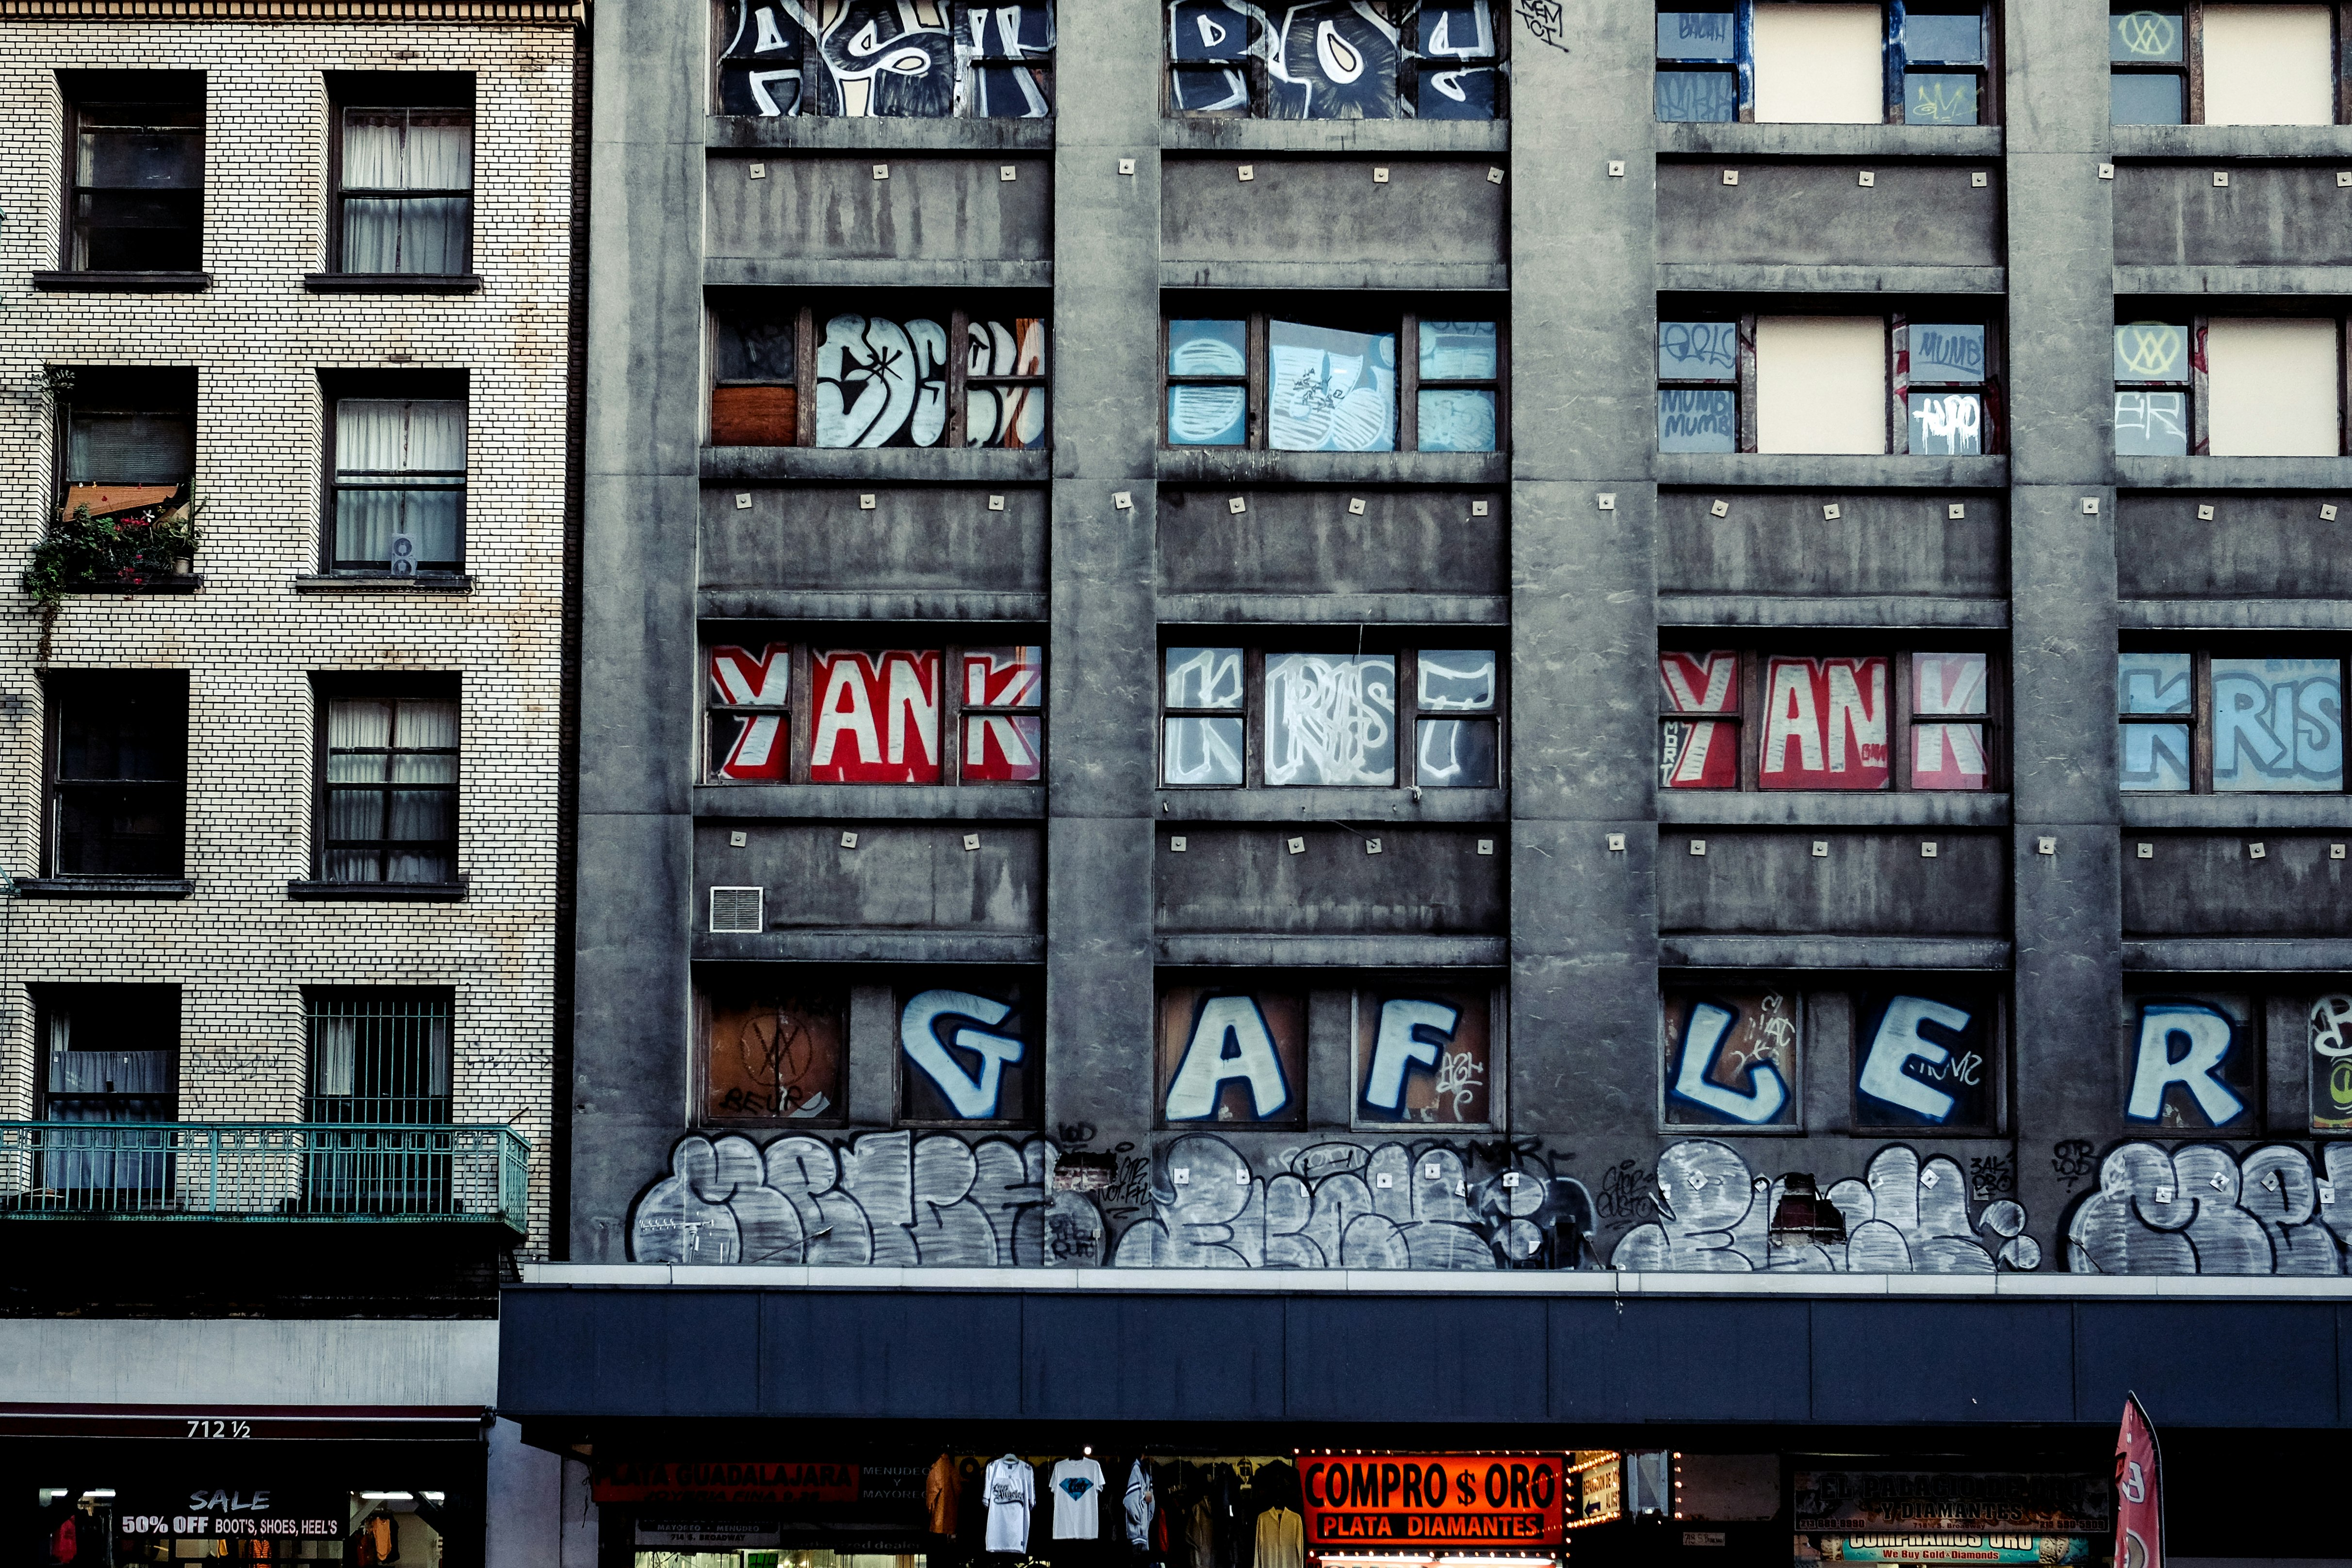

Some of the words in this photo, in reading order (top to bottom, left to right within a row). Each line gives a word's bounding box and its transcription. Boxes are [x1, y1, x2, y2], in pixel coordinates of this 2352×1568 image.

[187, 1421, 225, 1438] 712
[675, 1465, 852, 1486] GUADALAJARA
[893, 1478, 901, 1487] Y
[1305, 1462, 1448, 1509] COMPRO
[1455, 1469, 1477, 1507] $
[1484, 1463, 1555, 1509] ORO
[1820, 1476, 1853, 1501] EL
[1862, 1475, 1976, 1498] PALACIO
[1985, 1476, 2024, 1498] DE
[189, 1489, 271, 1513] SALE
[1881, 1502, 1894, 1520] Y
[1901, 1502, 2023, 1520] DIAMANTES
[122, 1516, 169, 1534] 50%
[173, 1516, 209, 1534] OFF
[215, 1519, 258, 1536] BOOT'S,
[261, 1519, 299, 1537] SHOES,
[302, 1519, 338, 1535] HEEL'S
[1323, 1516, 1392, 1537] PLATA
[1407, 1517, 1537, 1537] DIAMANTES
[874, 1540, 921, 1550] dealer
[1883, 1550, 1899, 1559] We
[1901, 1550, 1920, 1560] Buy
[1923, 1550, 1945, 1559] Gold
[1951, 1551, 1998, 1559] Diamonds
